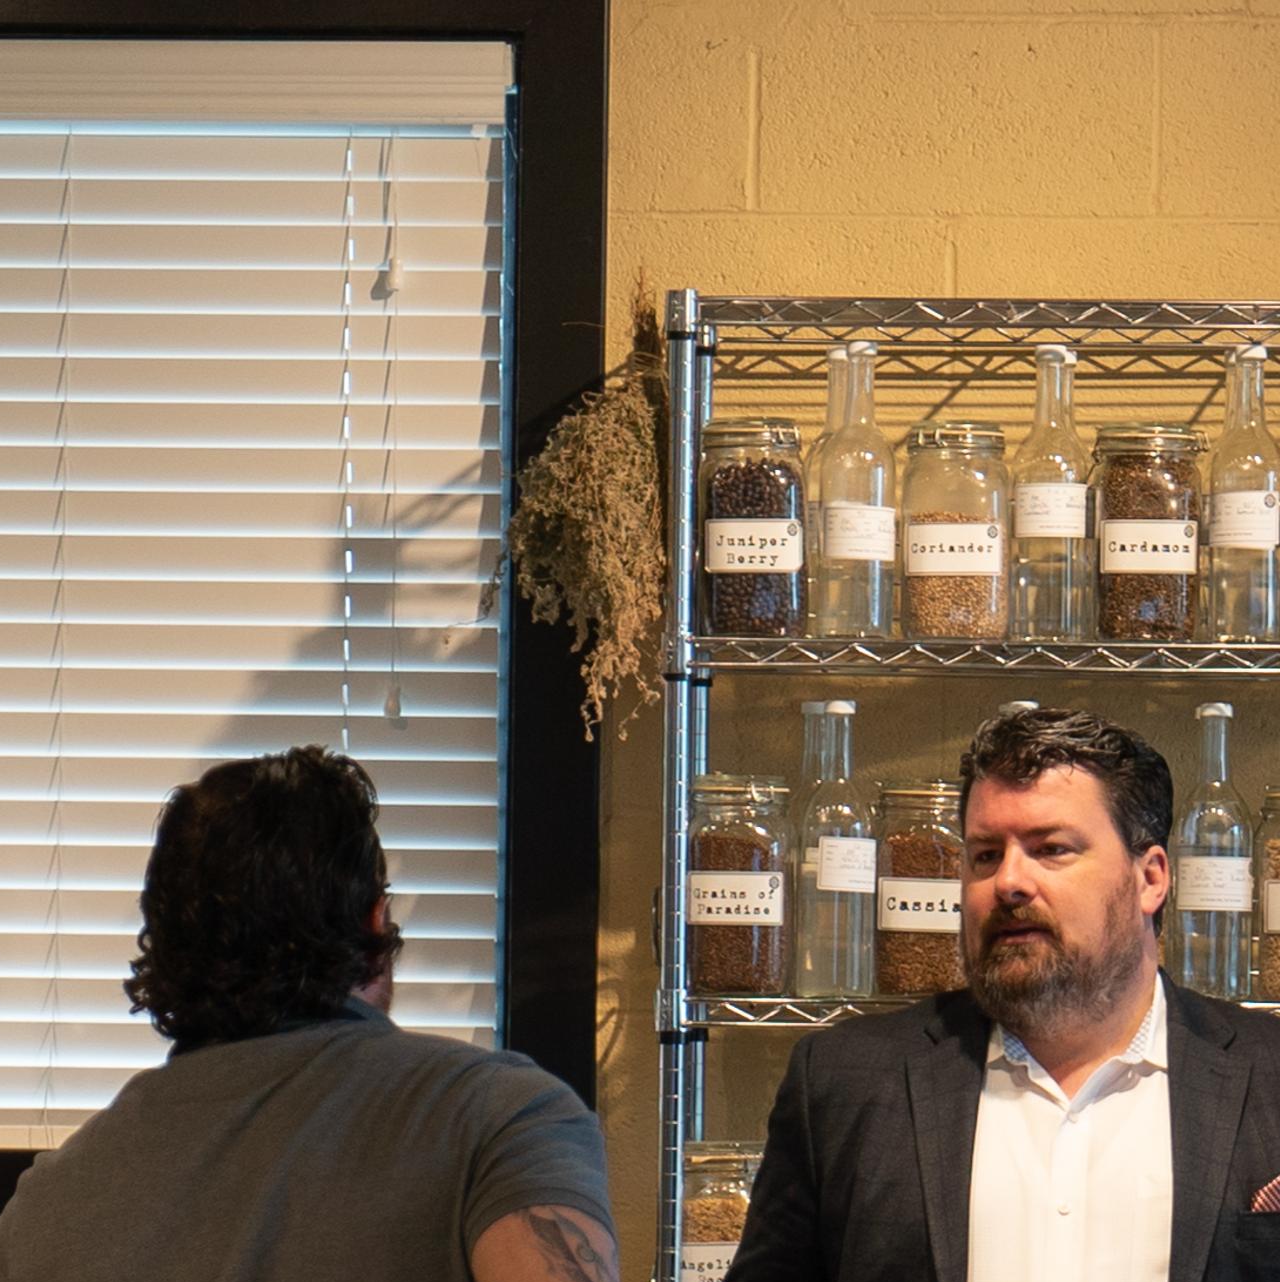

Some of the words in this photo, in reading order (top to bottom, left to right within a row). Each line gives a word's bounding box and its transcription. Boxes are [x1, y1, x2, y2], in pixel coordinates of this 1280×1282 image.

[716, 535, 788, 549] Juniper
[911, 543, 994, 555] Coriander
[727, 553, 779, 567] Berry
[693, 888, 746, 900] Grains
[758, 888, 775, 900] of
[697, 904, 770, 915] Paradise
[887, 896, 961, 912] Cassia
[681, 1258, 730, 1273] Angeli
